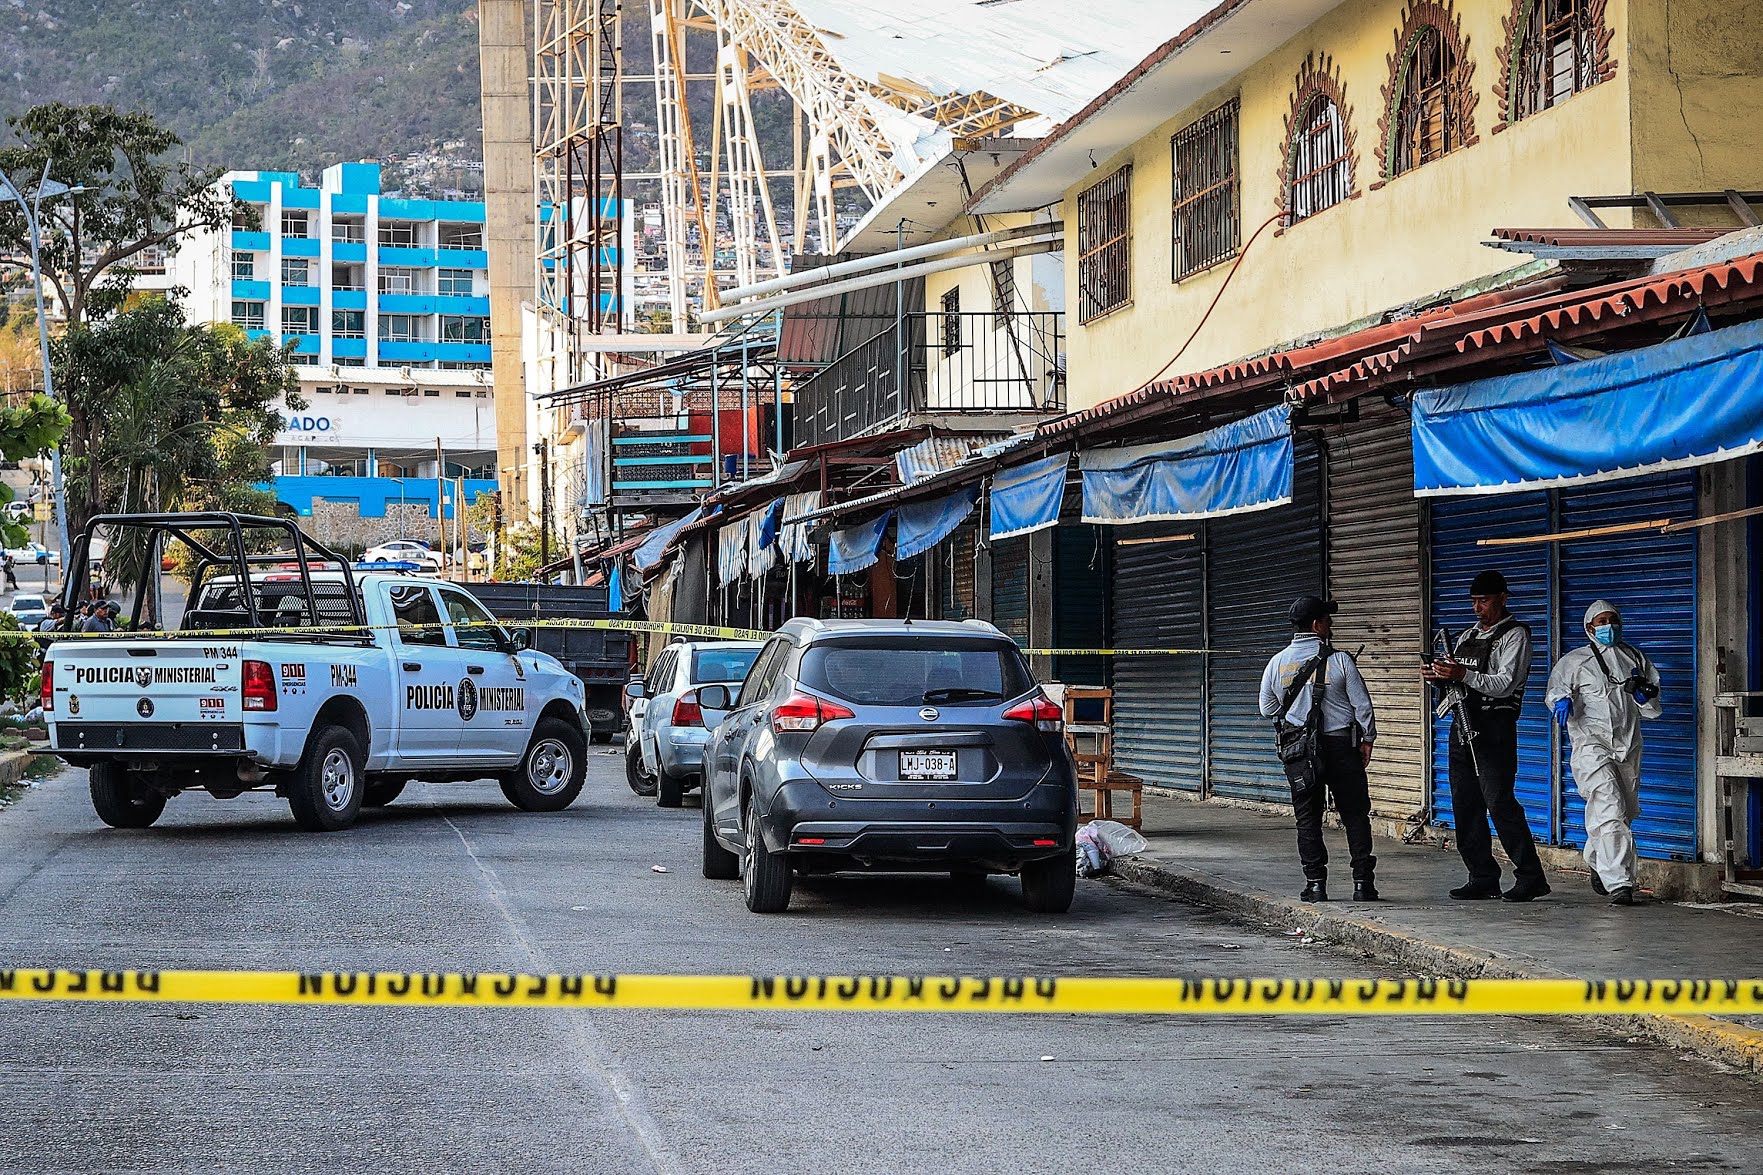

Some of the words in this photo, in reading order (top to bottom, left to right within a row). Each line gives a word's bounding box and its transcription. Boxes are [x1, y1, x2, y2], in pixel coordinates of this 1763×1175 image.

[203, 648, 218, 659] PM
[220, 646, 237, 659] 344
[77, 667, 134, 683] POLICIA
[154, 667, 216, 683] MINISTERIAL
[282, 664, 305, 677] 911
[331, 665, 357, 687] PM-344
[406, 681, 454, 709] POLICÍA
[480, 688, 524, 711] MINISTERIAL
[201, 699, 223, 708] 911
